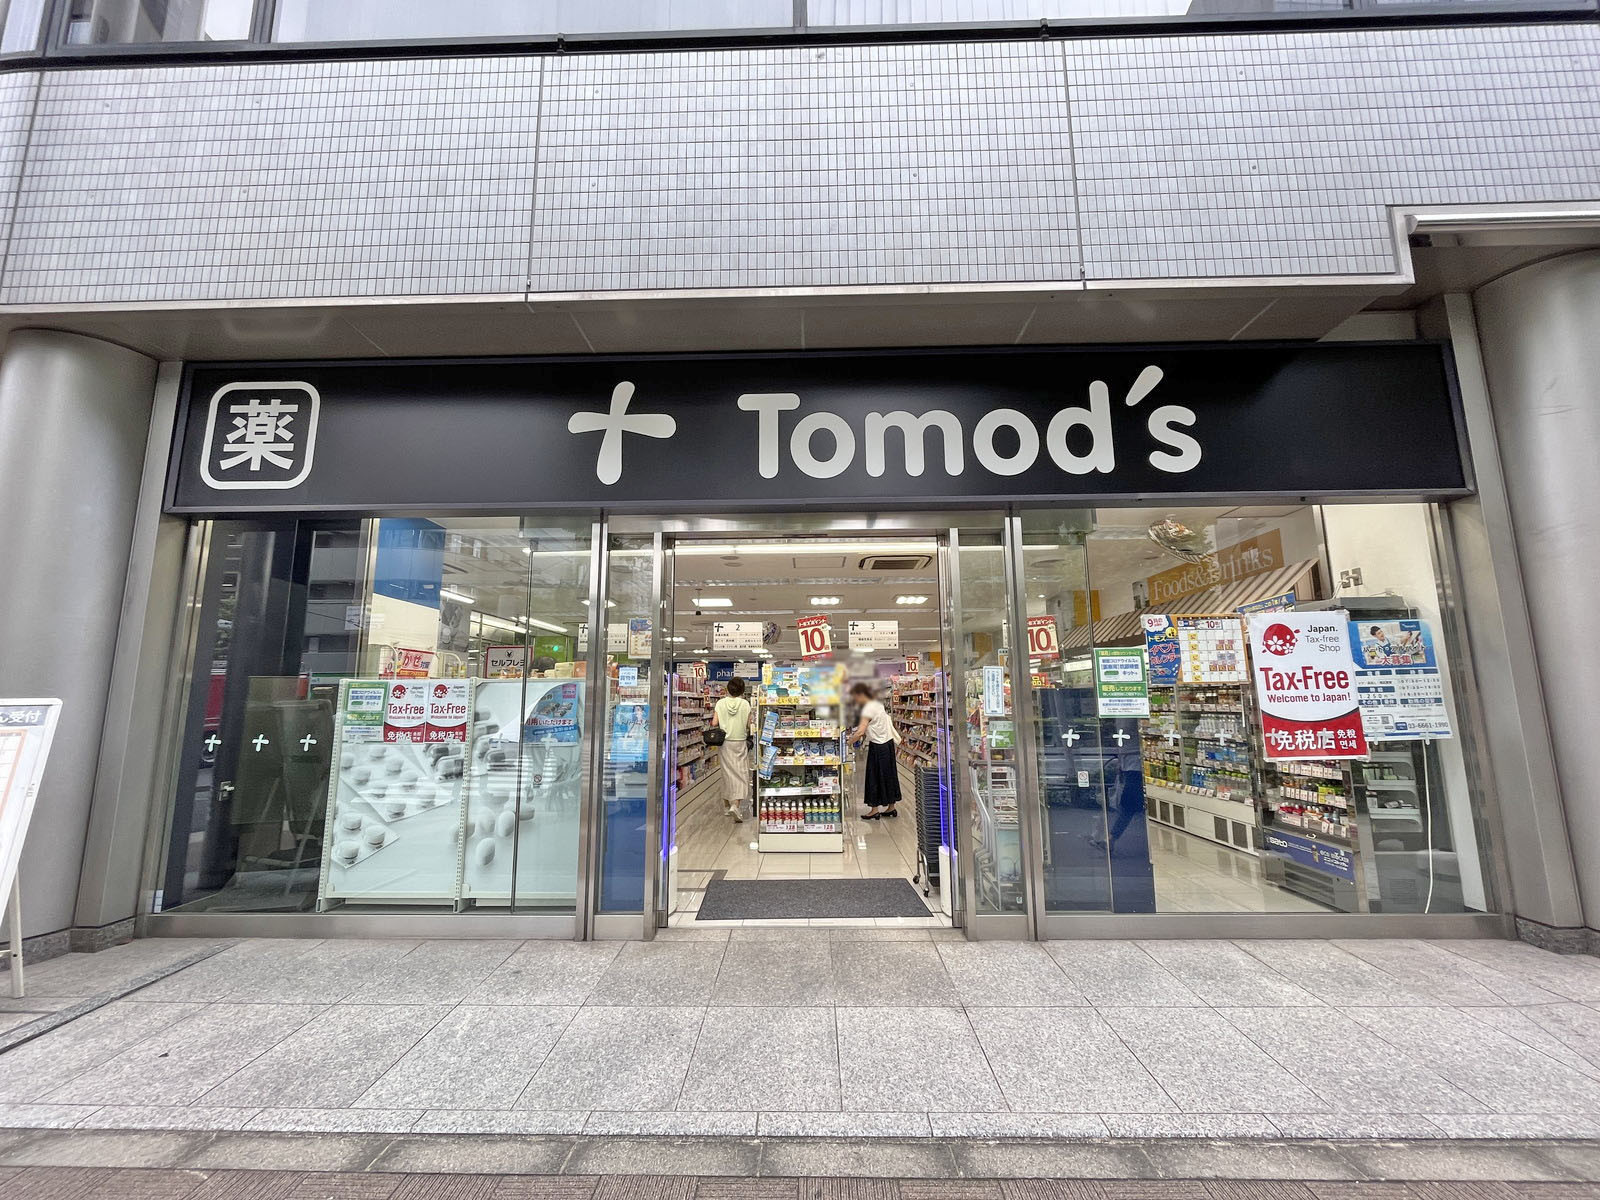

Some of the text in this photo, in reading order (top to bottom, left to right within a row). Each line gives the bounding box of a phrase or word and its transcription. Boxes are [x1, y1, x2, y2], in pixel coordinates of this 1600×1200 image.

[737, 364, 1202, 479] Tomod's
[219, 398, 299, 473] 薬
[1307, 625, 1339, 634] Japan.
[1305, 635, 1340, 643] Tax-free
[1318, 644, 1341, 653] Shop
[1259, 666, 1350, 691] Tax-Free
[1267, 692, 1351, 704] Welcome to Japan!
[388, 703, 424, 714] Tax-Free
[430, 703, 466, 714] Tax-Free
[1277, 727, 1336, 751] 免税店
